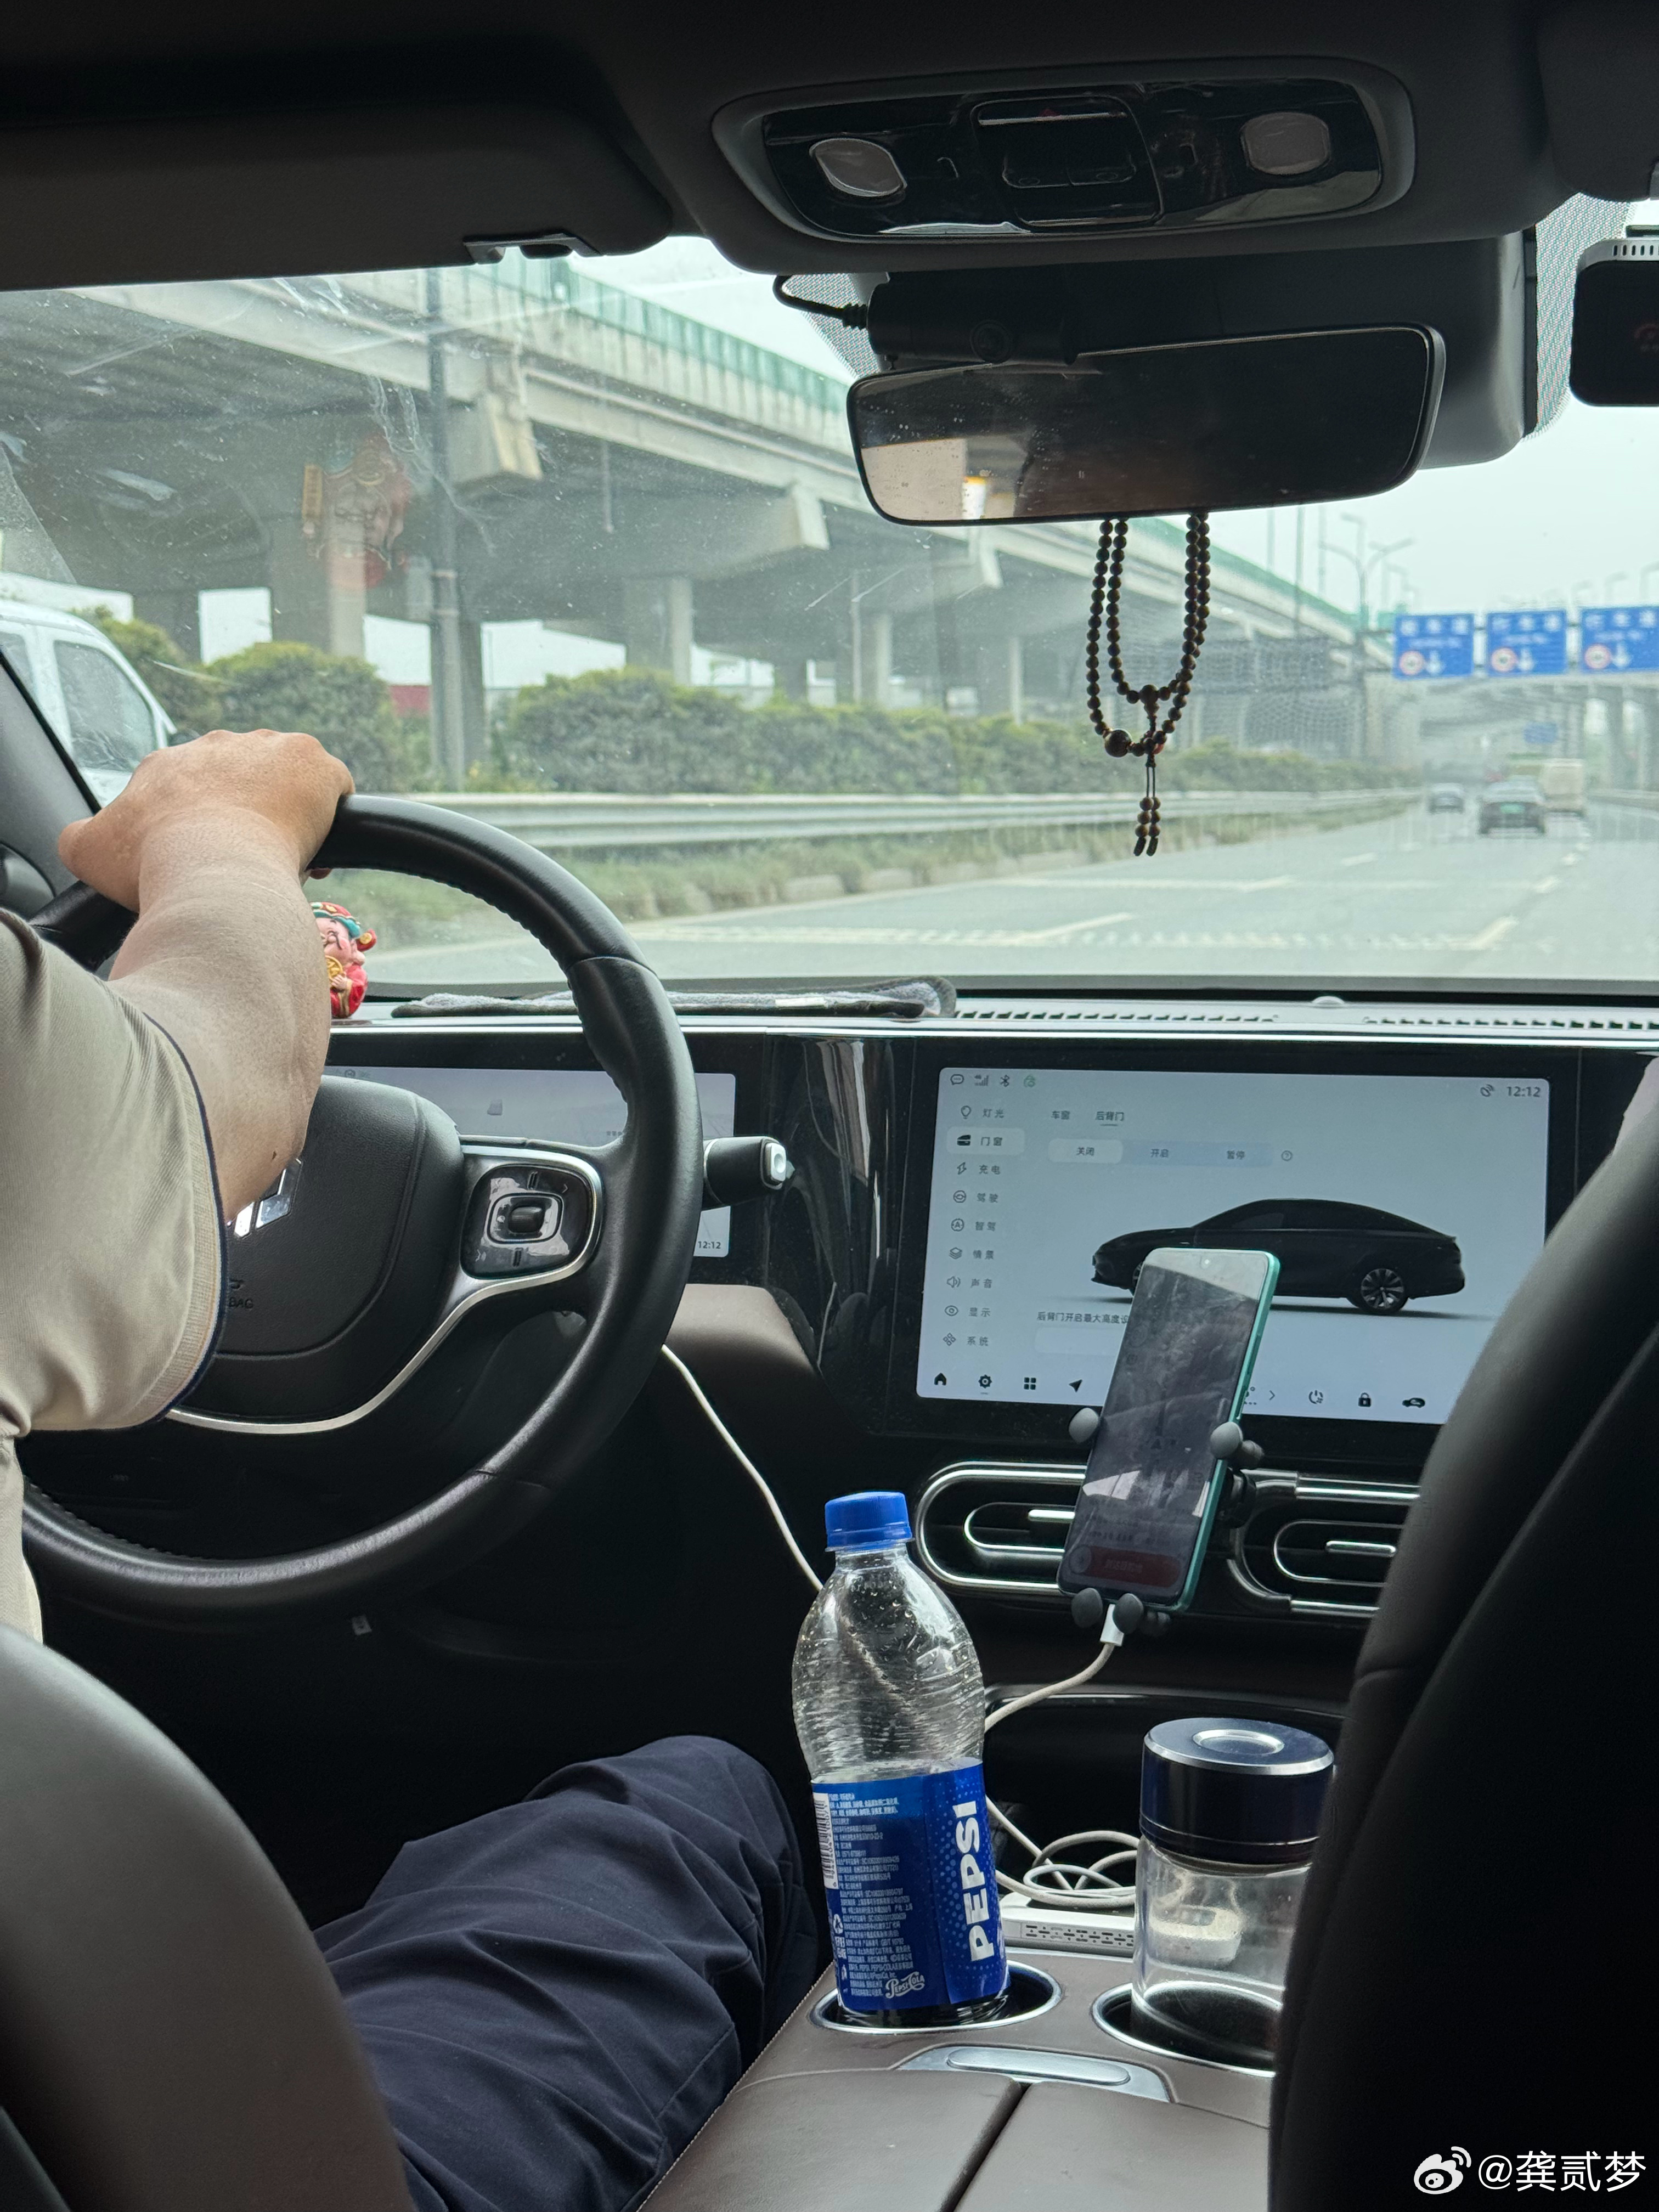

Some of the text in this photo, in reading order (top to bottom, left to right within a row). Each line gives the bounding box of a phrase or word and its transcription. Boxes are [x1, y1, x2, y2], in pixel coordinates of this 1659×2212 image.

[1506, 1086, 1541, 1097] 12:12
[983, 1108, 1004, 1118] 灯光
[1051, 1110, 1070, 1120] 车窗
[1095, 1111, 1124, 1121] 后背门
[980, 1137, 1003, 1146] 门窗
[1076, 1147, 1094, 1156] 关闭
[1150, 1148, 1169, 1158] 开启
[1227, 1150, 1245, 1160] 暂停
[978, 1164, 1001, 1175] 充电
[977, 1193, 998, 1203] 驾驶
[975, 1221, 996, 1232] 智驾
[698, 1241, 721, 1249] 12:12
[970, 1278, 992, 1288] 声音
[969, 1307, 990, 1317] 显示
[967, 1336, 989, 1346] 系统
[953, 1800, 995, 1962] PEPSI
